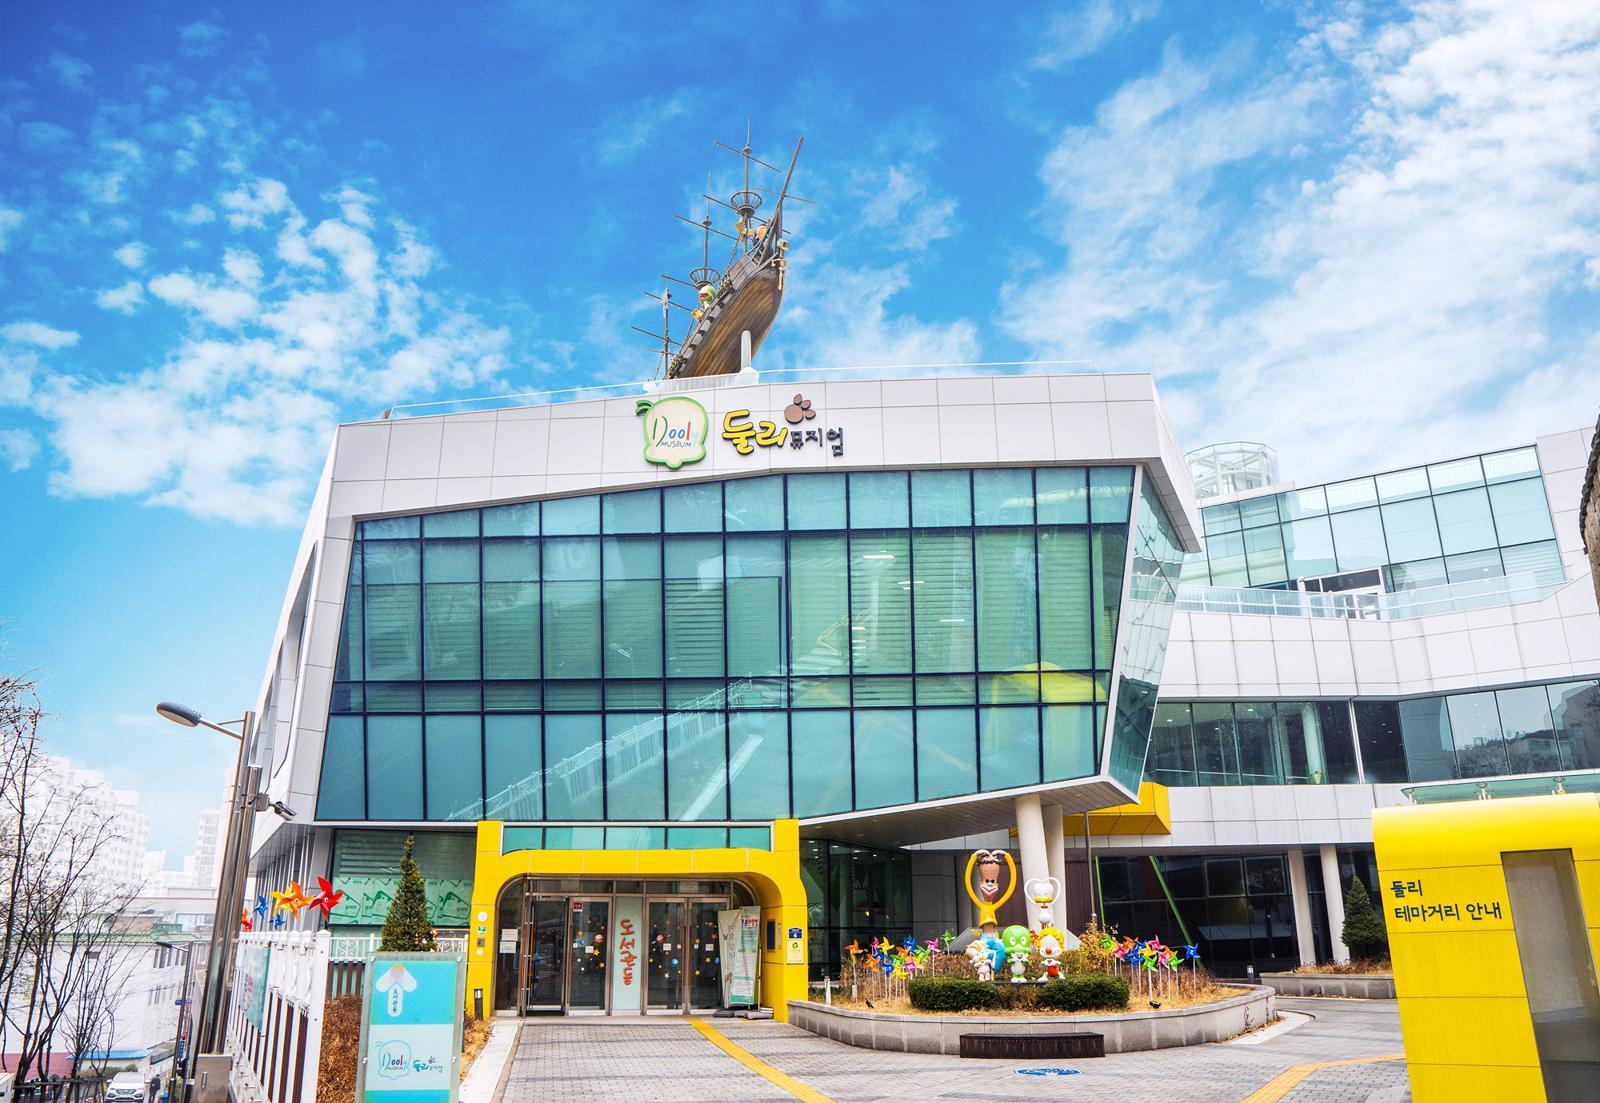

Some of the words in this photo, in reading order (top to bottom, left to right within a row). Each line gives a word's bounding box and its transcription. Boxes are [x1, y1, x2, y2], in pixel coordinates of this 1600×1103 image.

[722, 409, 788, 455] 둘리
[790, 427, 843, 457] 뮤지엄
[660, 440, 692, 448] MUSEUM
[1390, 879, 1423, 898] 둘리
[1394, 903, 1460, 922] 테마거리
[1465, 901, 1502, 920] 안내
